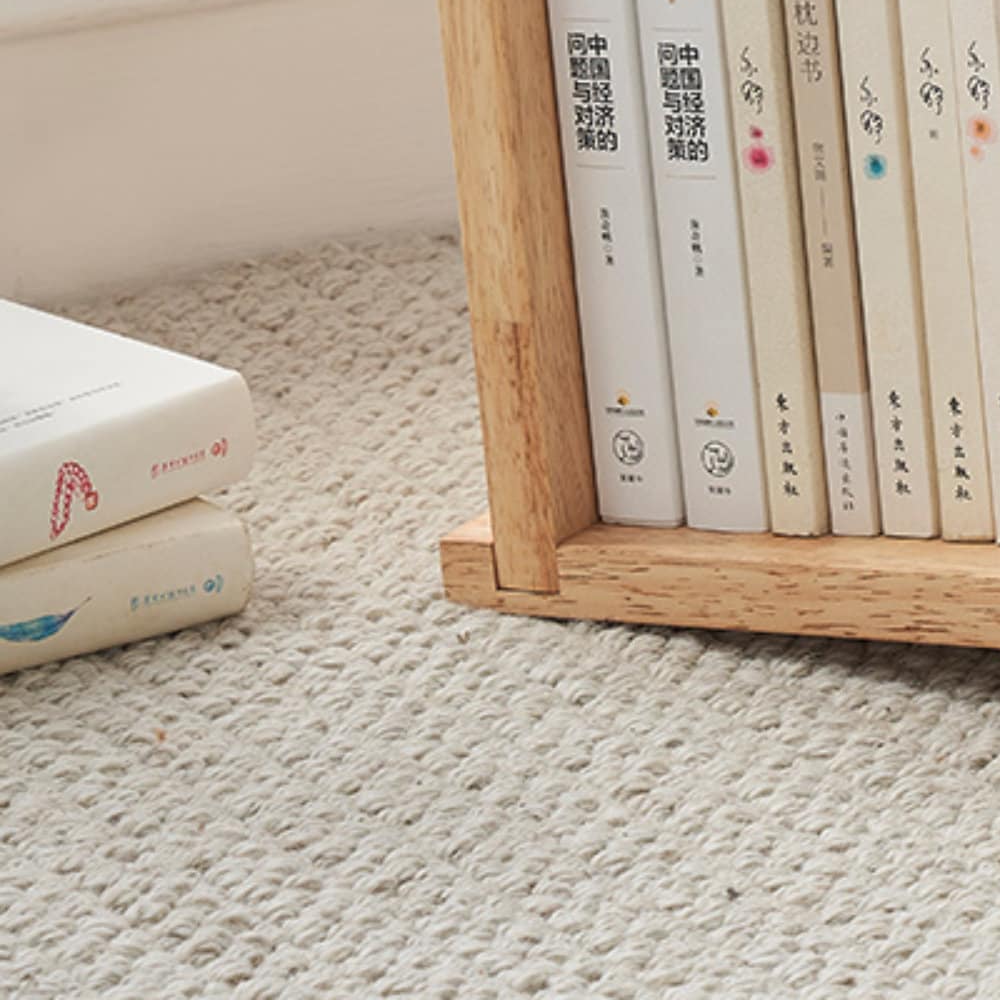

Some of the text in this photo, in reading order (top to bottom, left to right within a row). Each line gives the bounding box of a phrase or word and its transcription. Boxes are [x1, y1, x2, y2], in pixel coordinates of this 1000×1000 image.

[567, 32, 597, 151] 问题与对策
[587, 33, 618, 152] 中国经济的
[679, 43, 709, 162] 中国经济的
